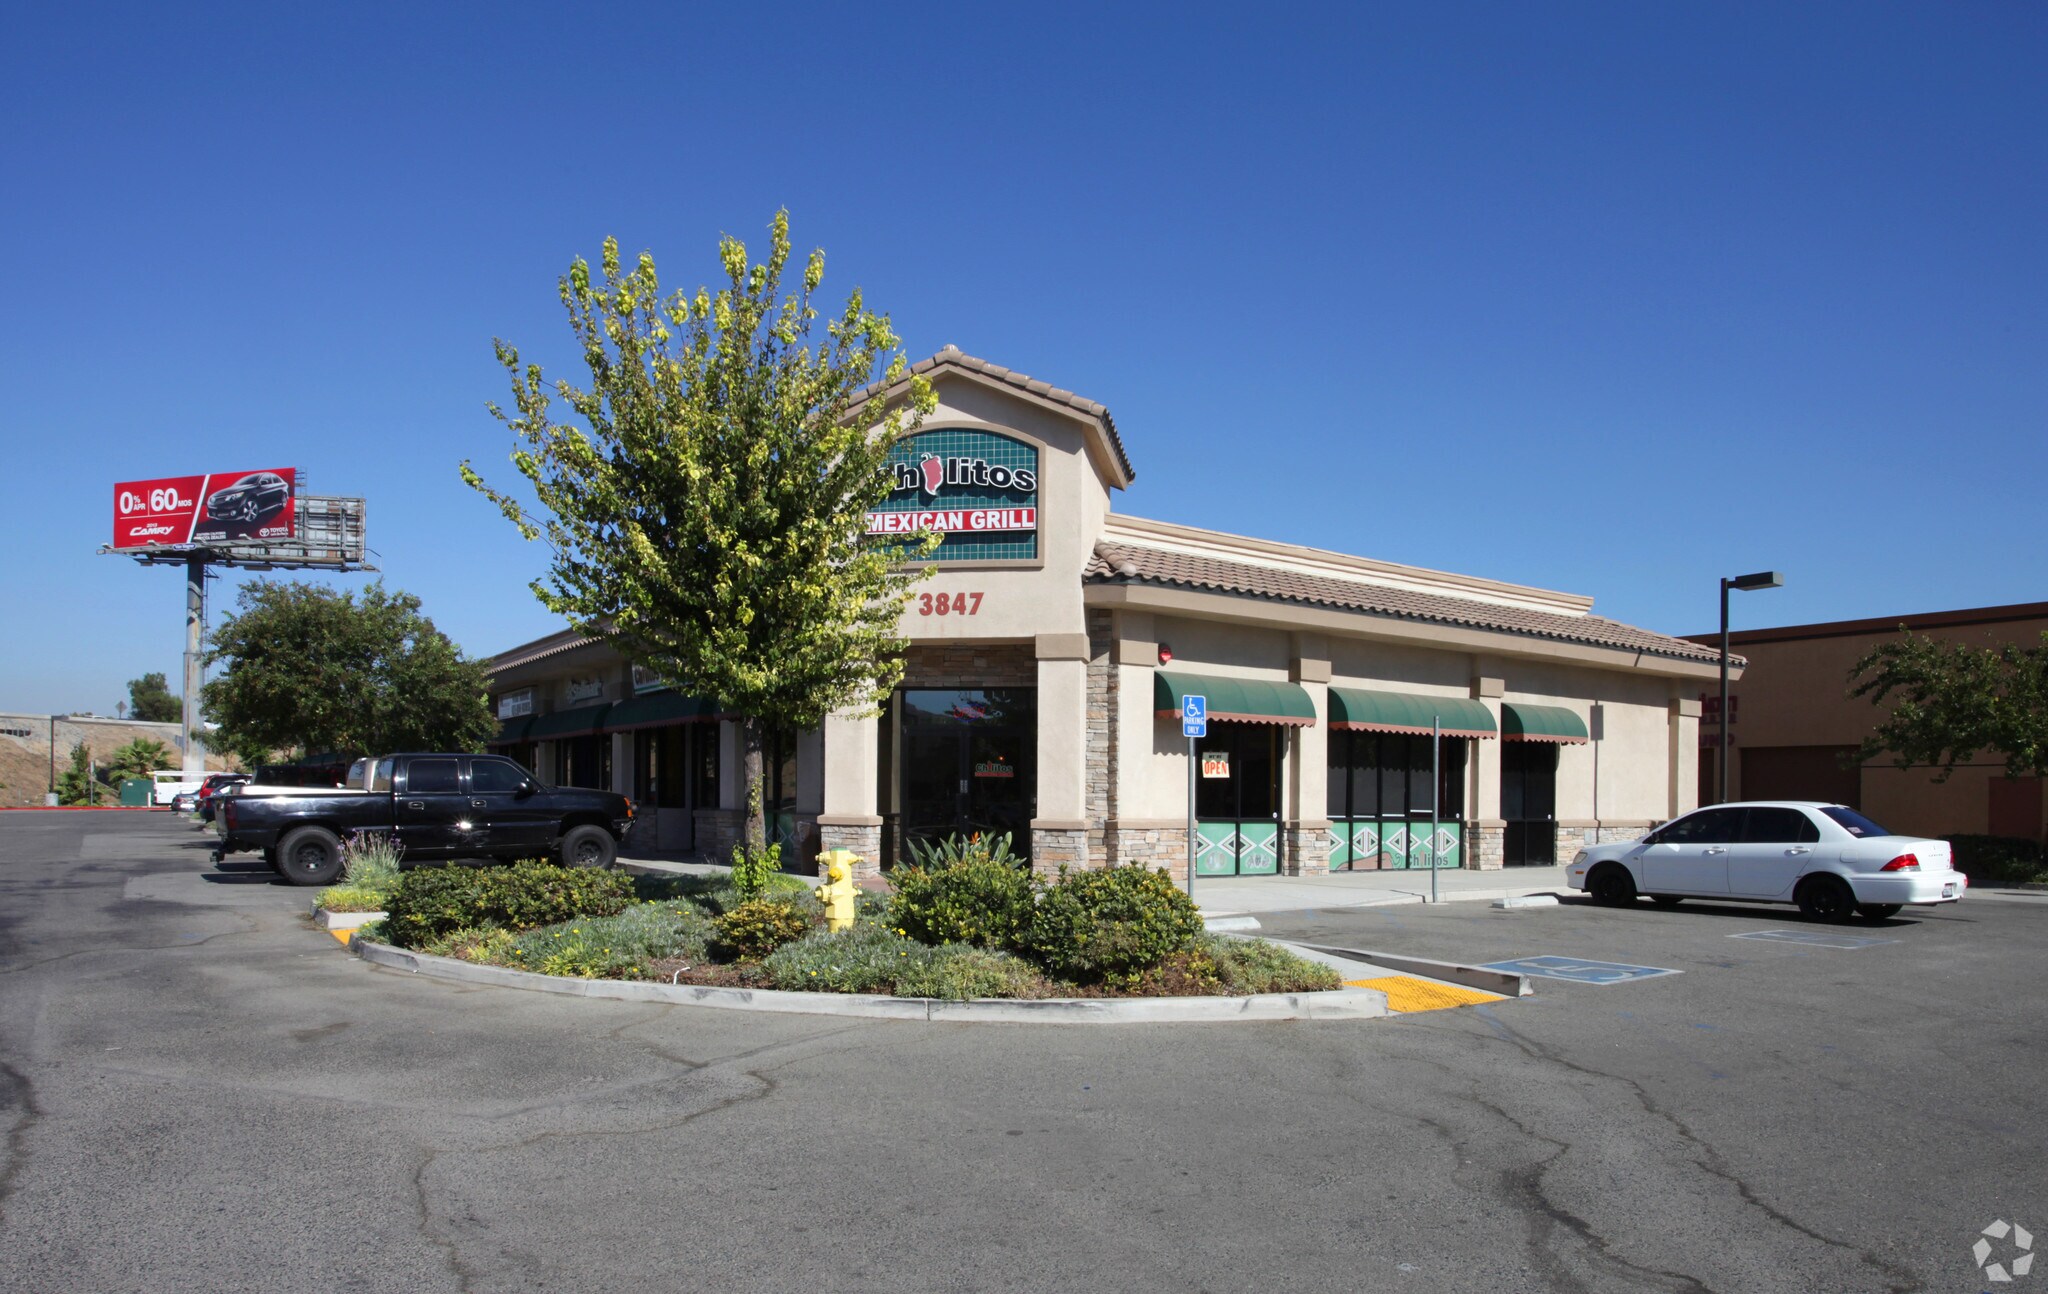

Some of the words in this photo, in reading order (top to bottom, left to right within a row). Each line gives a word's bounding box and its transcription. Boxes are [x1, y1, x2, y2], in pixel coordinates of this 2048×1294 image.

[875, 452, 1037, 495] hilitos
[133, 503, 146, 511] APR
[150, 488, 178, 512] 60
[177, 499, 193, 507] MOS
[866, 511, 964, 532] MEXICAN
[970, 510, 1034, 530] GRILL
[918, 592, 984, 616] 3847
[1184, 715, 1204, 725] PARKING
[1187, 726, 1200, 734] ONLY
[1204, 761, 1227, 775] OPEN
